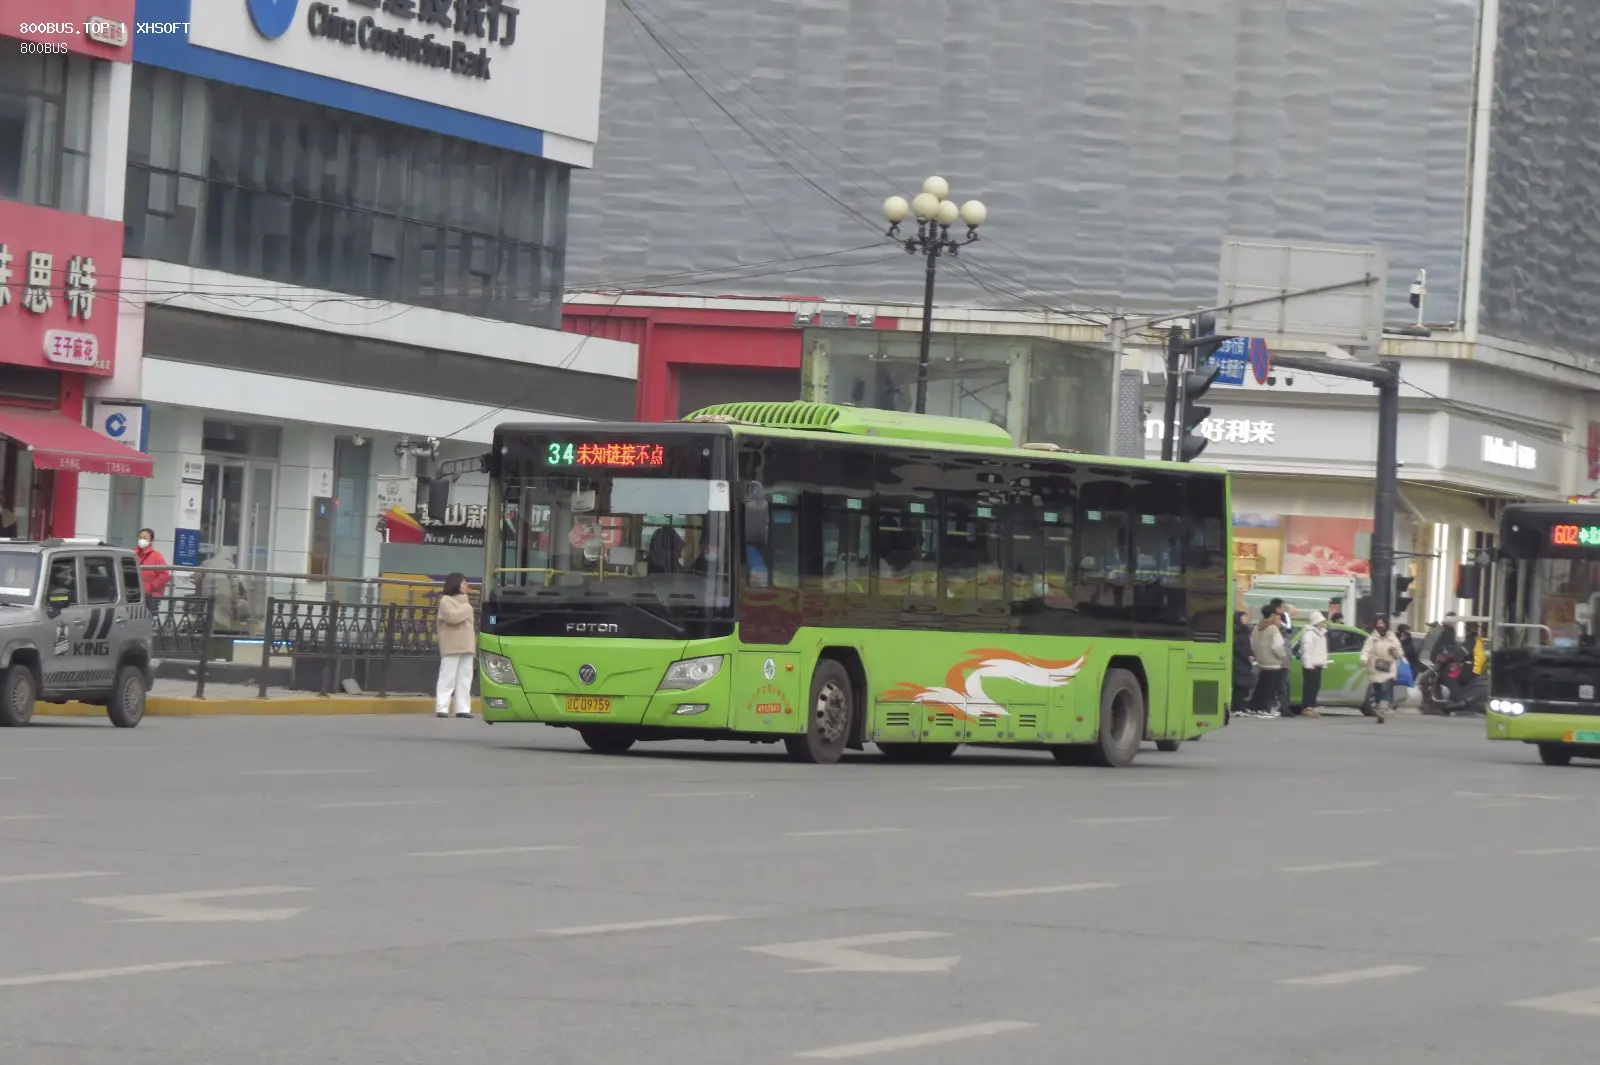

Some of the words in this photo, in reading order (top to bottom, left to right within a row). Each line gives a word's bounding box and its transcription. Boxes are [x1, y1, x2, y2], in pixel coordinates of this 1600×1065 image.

[308, 2, 357, 45] China
[452, 40, 491, 80] Bank
[53, 336, 94, 361] 王子麻花
[1200, 417, 1276, 443] 好利来
[548, 443, 574, 465] 34
[576, 443, 664, 466] 未知链接不点
[1554, 525, 1579, 544] 602
[566, 623, 618, 633] FOTON
[73, 641, 109, 656] KING
